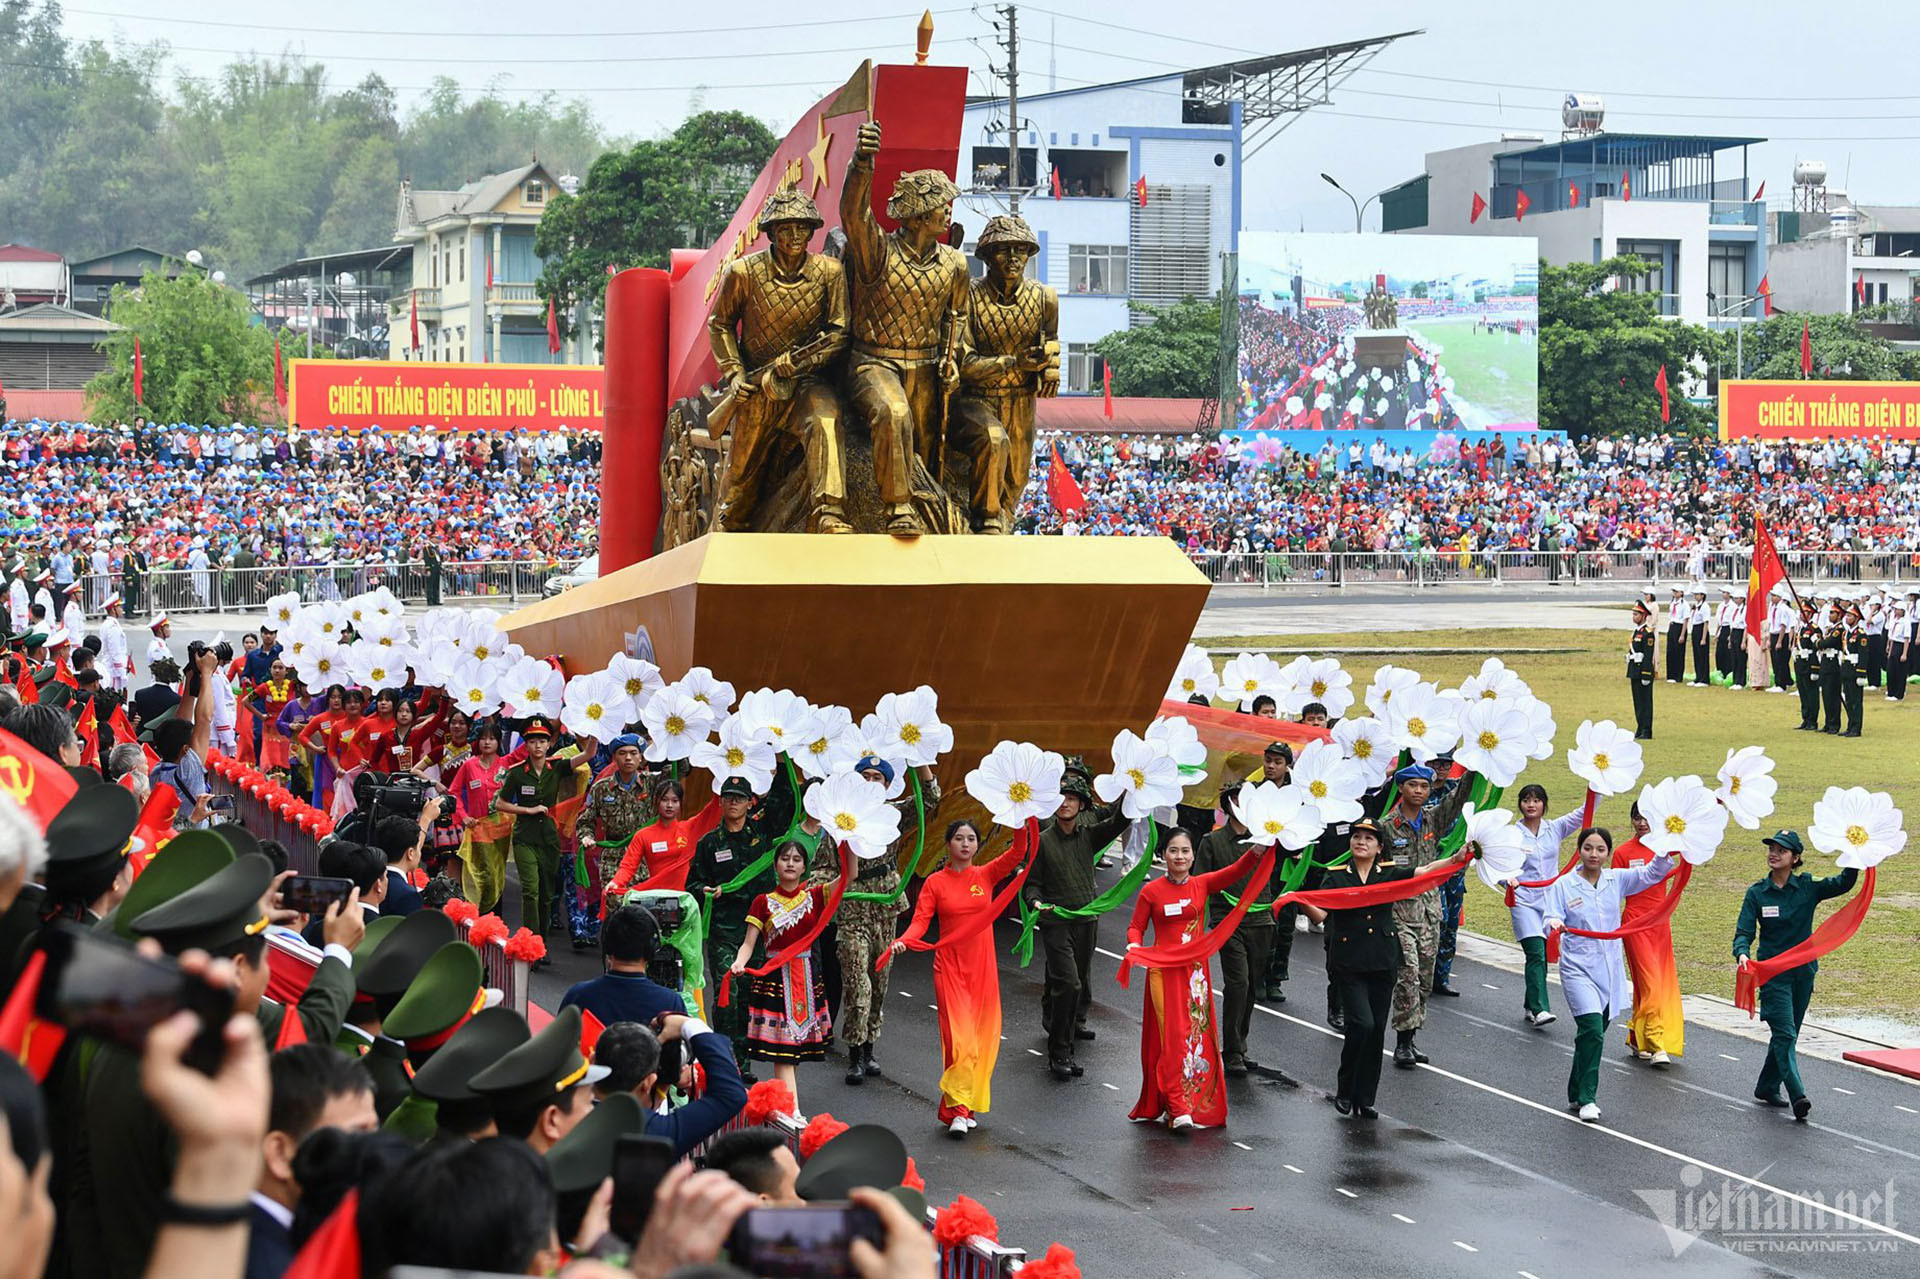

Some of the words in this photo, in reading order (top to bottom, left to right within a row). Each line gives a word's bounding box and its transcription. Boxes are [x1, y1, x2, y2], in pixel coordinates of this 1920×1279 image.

[328, 376, 373, 415] CHIẾN
[375, 375, 424, 416] THẮNG
[427, 381, 463, 422] ĐIỆN
[466, 381, 502, 416] BIÊN
[505, 379, 536, 417] PHỦ
[550, 383, 590, 417] LỪNG
[593, 389, 604, 417] L
[1758, 393, 1805, 427] CHIẾN
[1808, 393, 1860, 427] THẮNG
[1863, 397, 1901, 433] ĐIỆN
